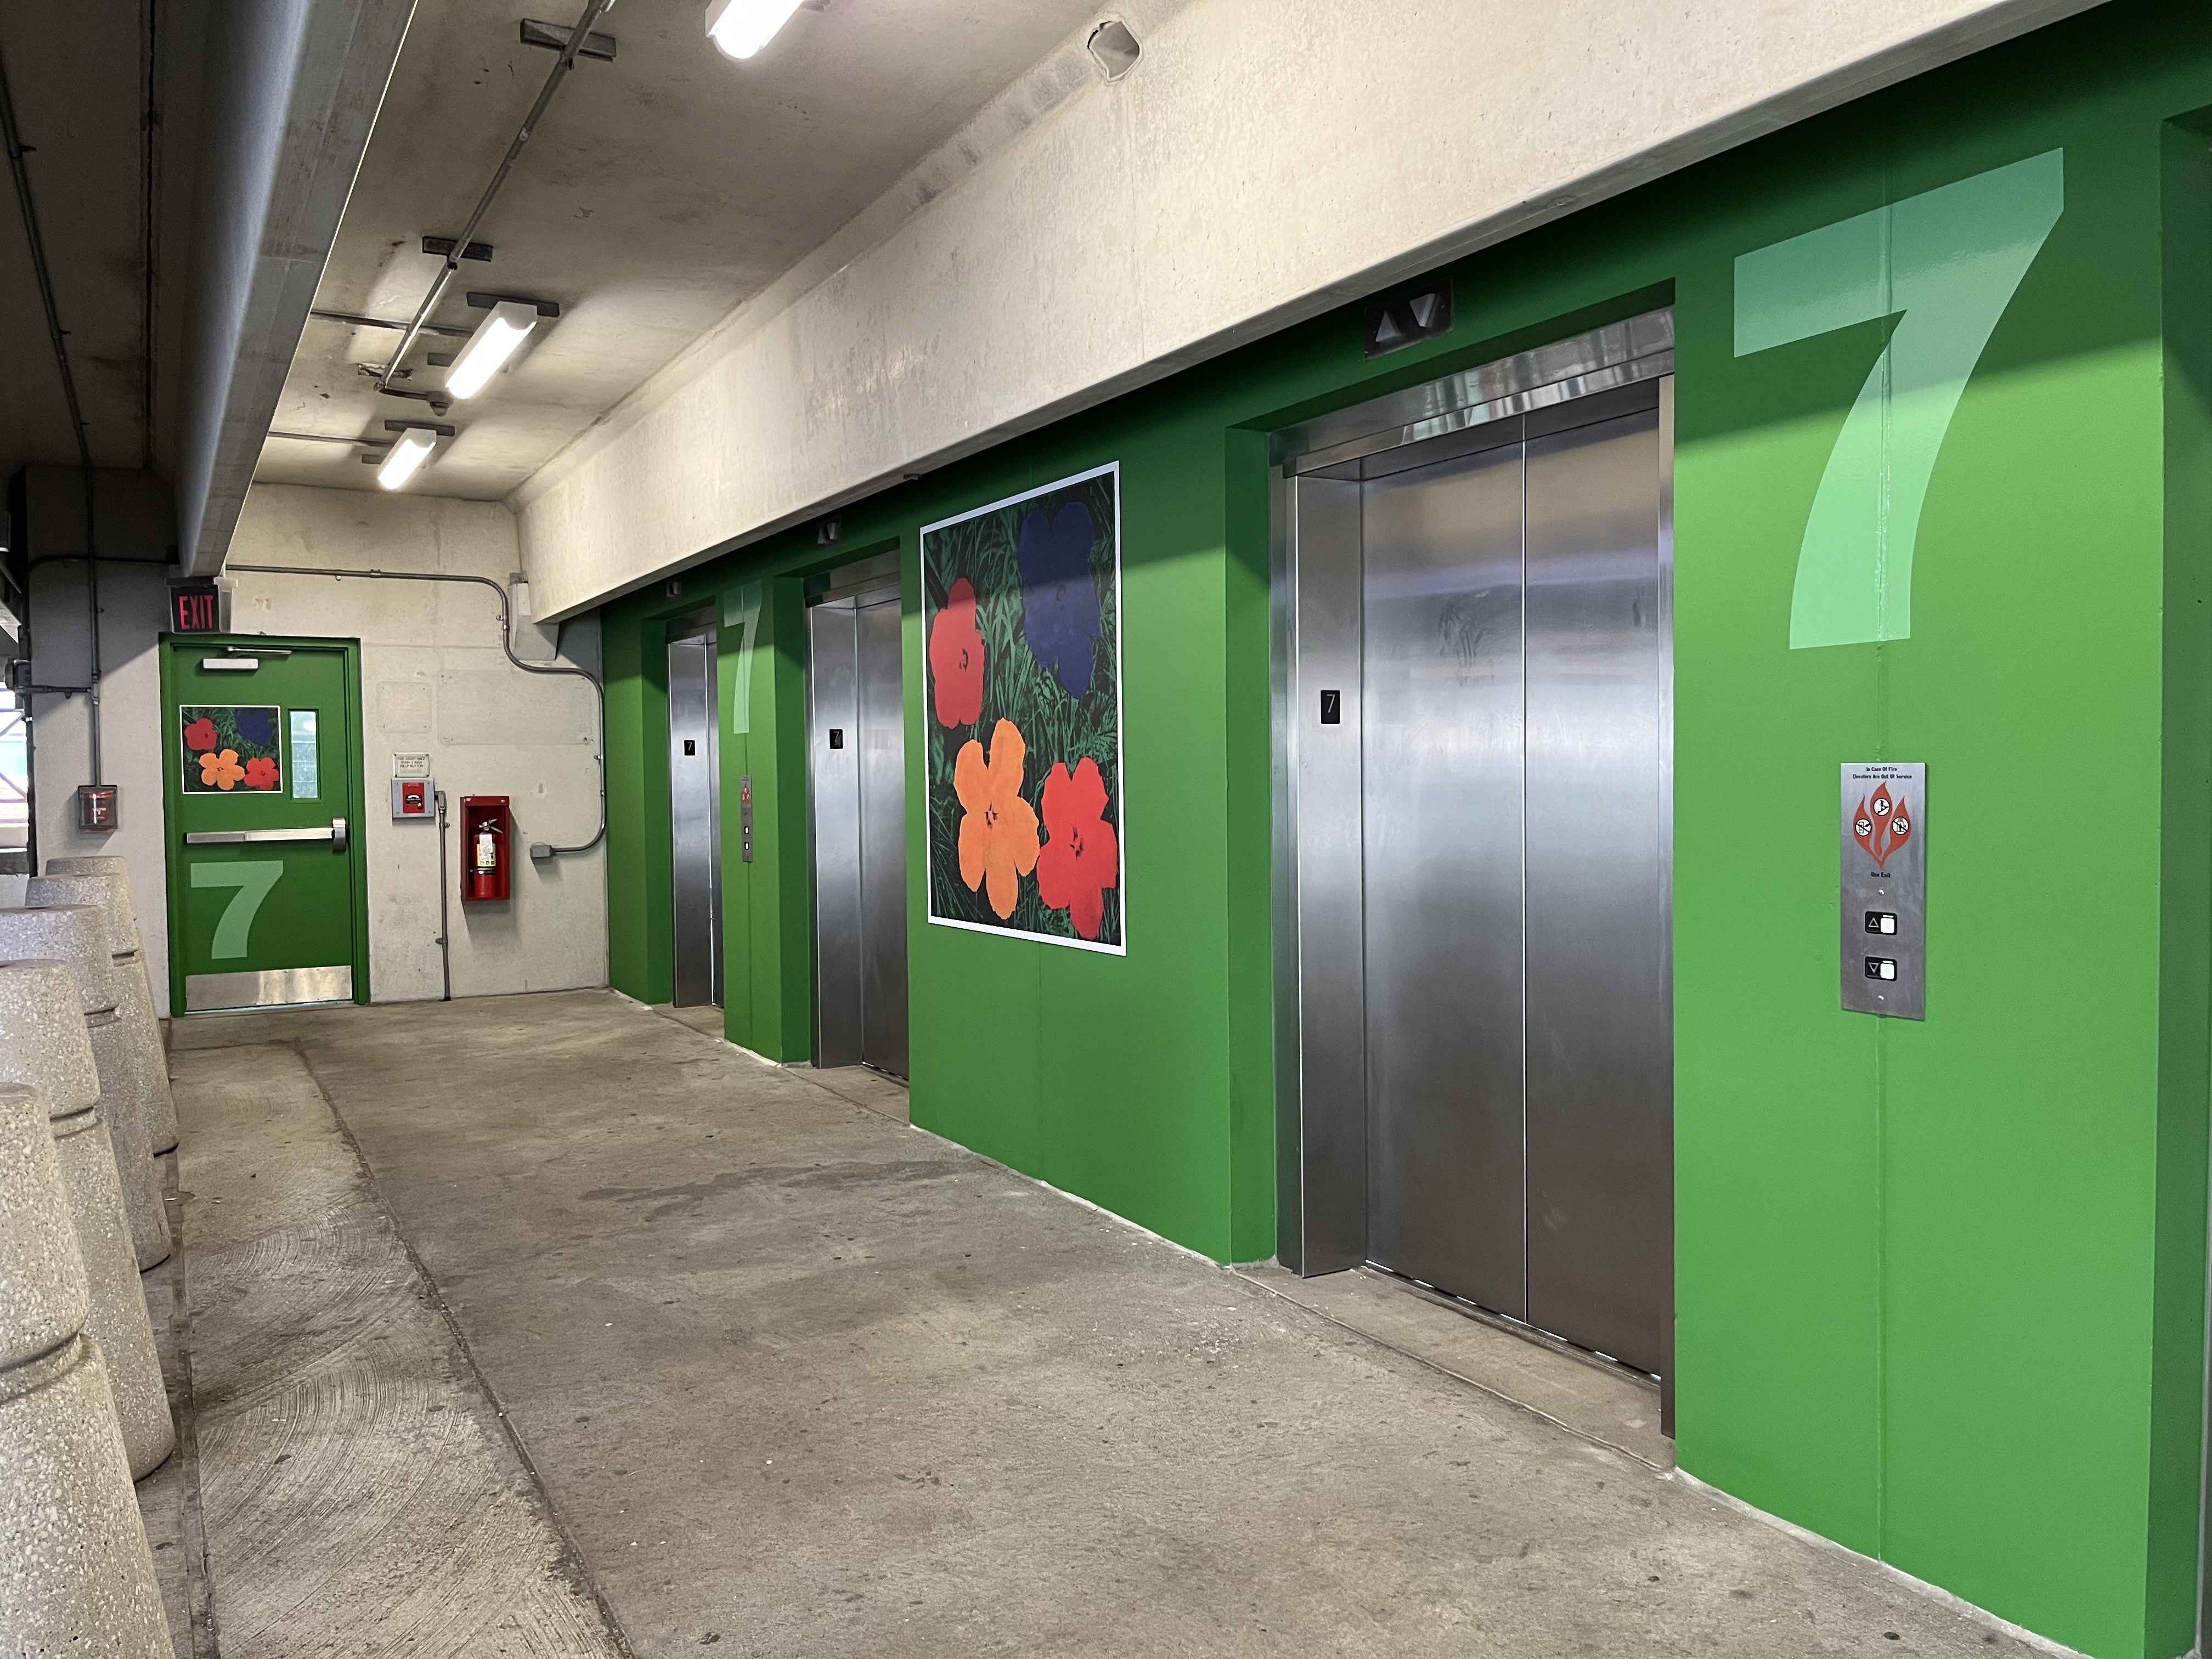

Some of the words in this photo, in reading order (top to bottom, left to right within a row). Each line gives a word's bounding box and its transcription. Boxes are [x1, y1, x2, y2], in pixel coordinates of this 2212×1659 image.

[1734, 148, 2064, 650] 7
[179, 595, 213, 629] EXIT
[724, 579, 763, 734] 7
[1327, 694, 1335, 713] 7
[687, 741, 692, 751] 7
[833, 731, 839, 742] 7
[190, 860, 284, 960] 7
